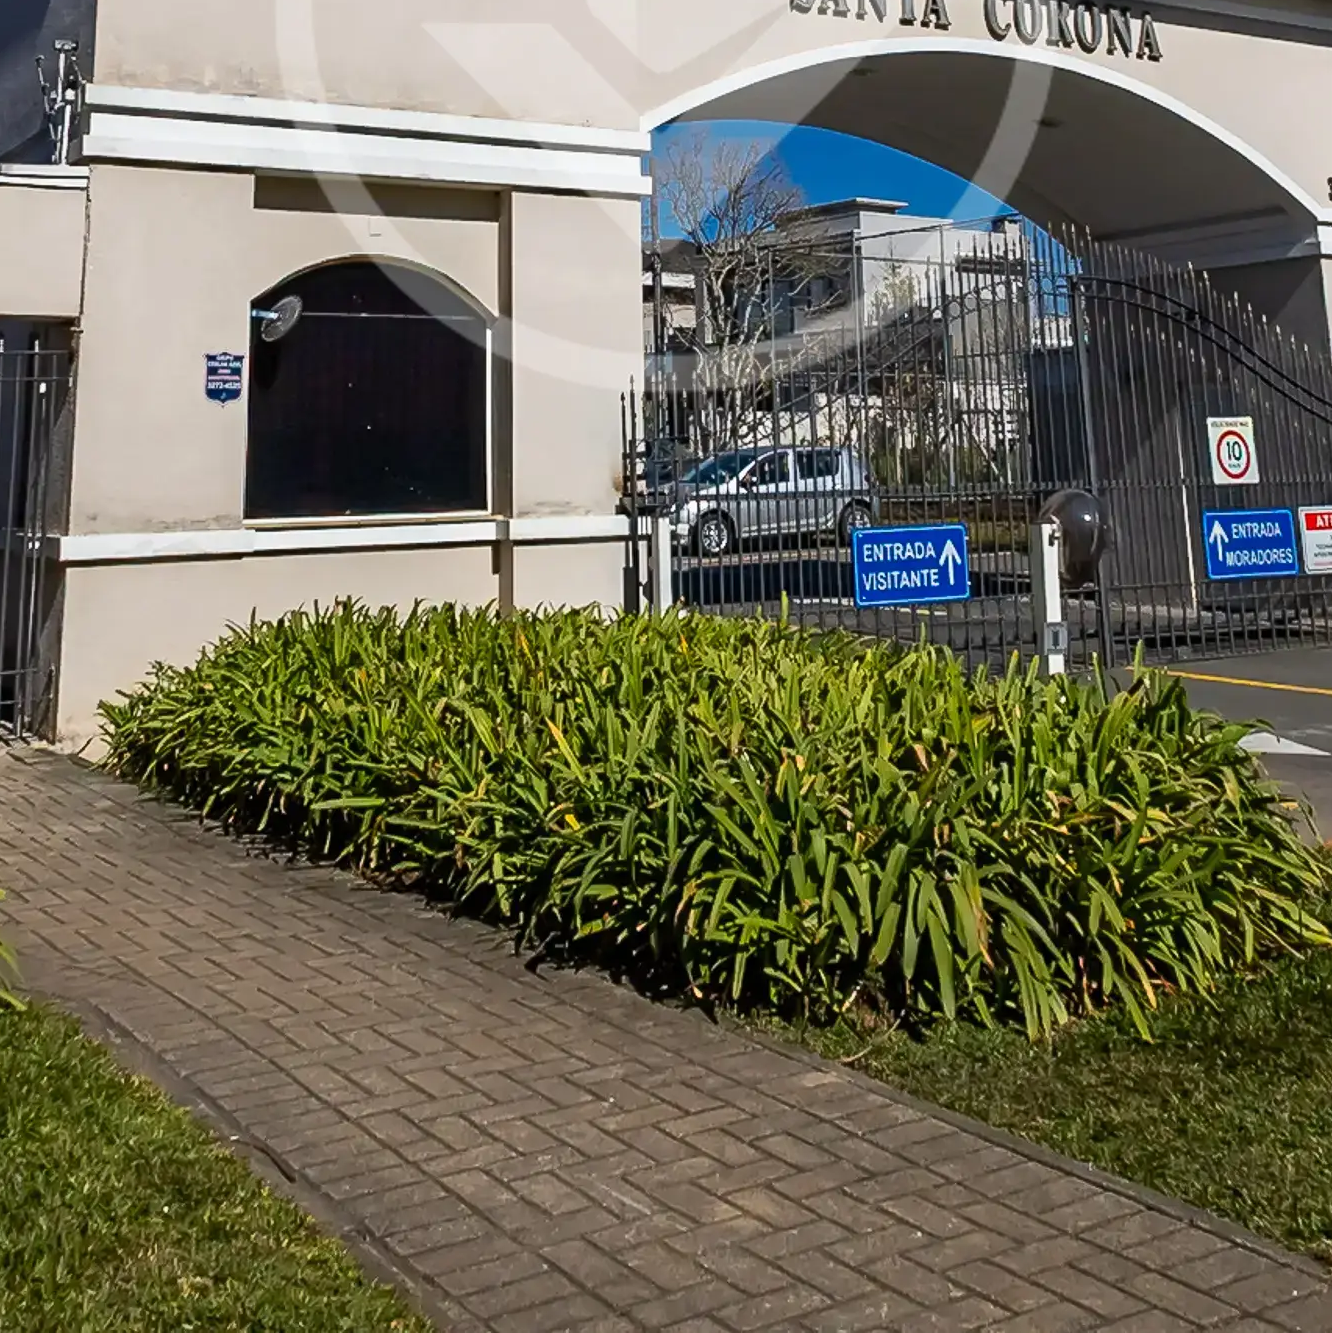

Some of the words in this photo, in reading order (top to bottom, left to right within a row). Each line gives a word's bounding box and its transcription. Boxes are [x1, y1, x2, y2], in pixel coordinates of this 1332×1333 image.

[1226, 440, 1243, 462] 10
[1231, 522, 1282, 539] ENTRADA
[863, 541, 936, 563] ENTRADA
[1226, 548, 1294, 567] MORADORES
[862, 568, 940, 592] VISITANTE
